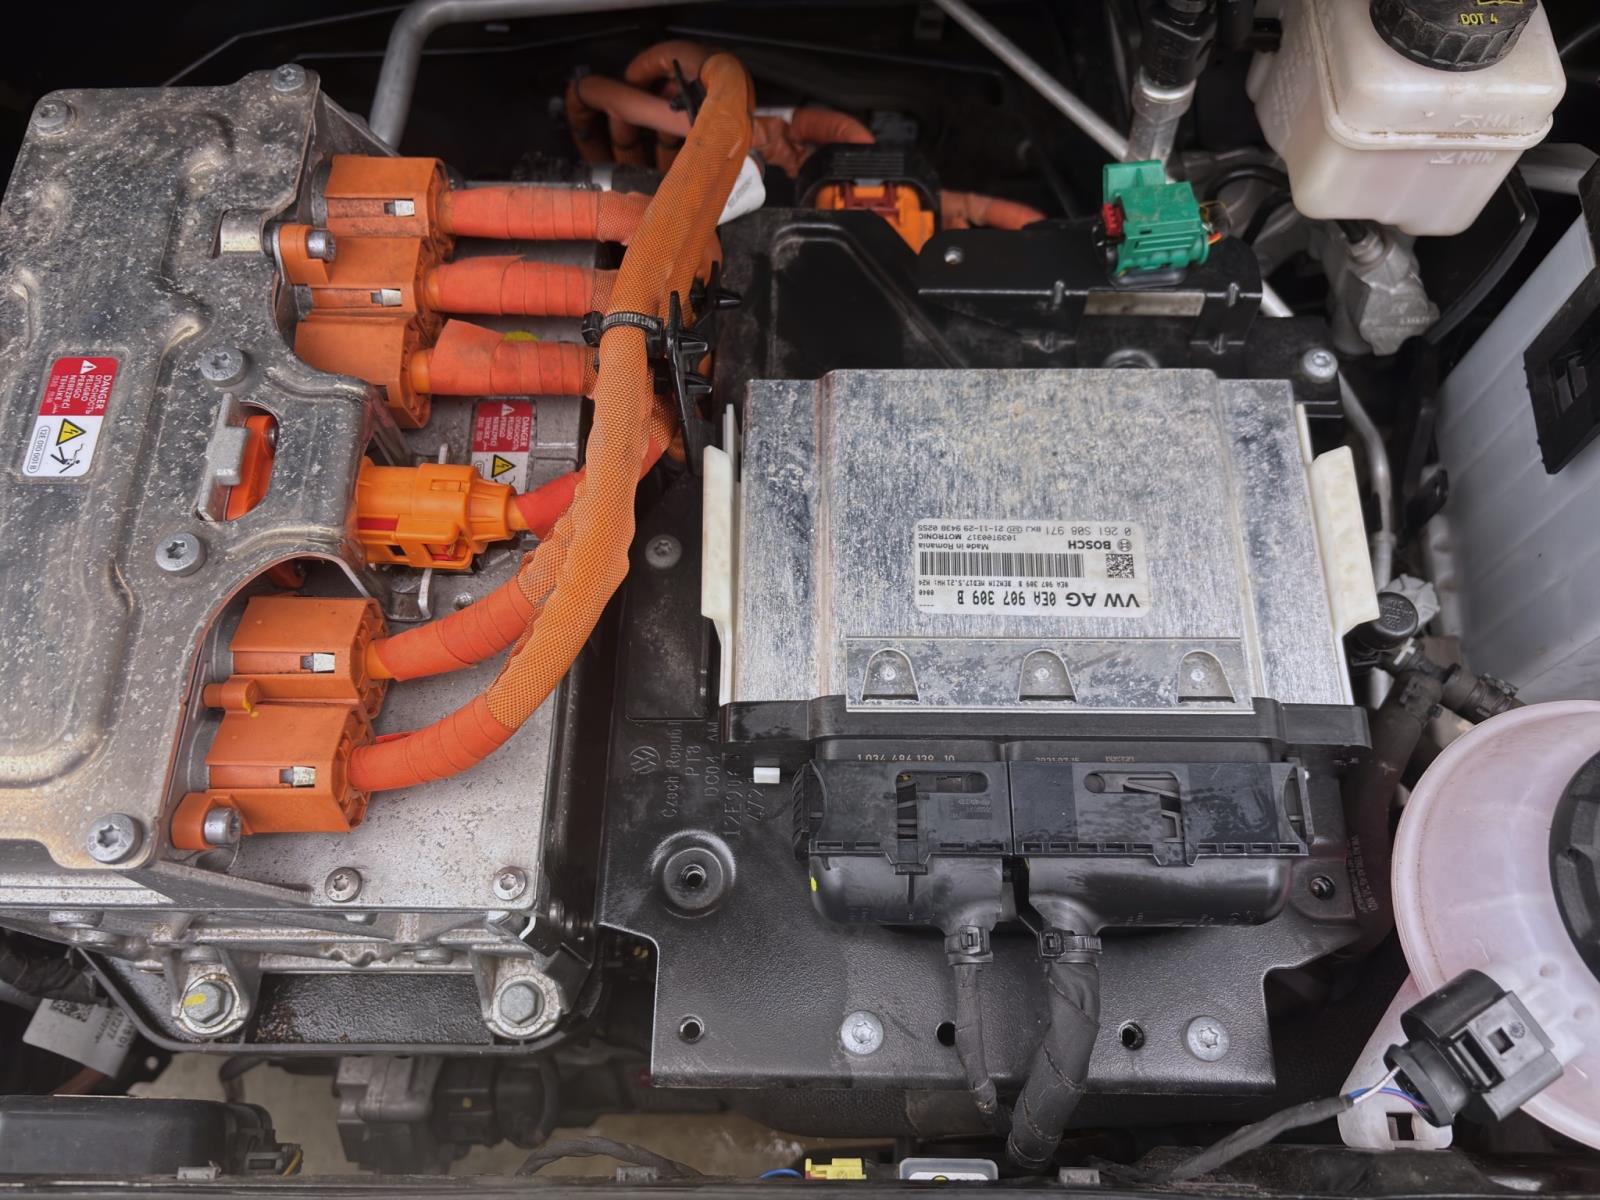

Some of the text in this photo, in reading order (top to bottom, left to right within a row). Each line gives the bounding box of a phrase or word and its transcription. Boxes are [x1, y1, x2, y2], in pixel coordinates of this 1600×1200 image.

[1460, 13, 1498, 25] DOT 4
[1458, 151, 1496, 165] MIN
[73, 375, 86, 398] PERIGO
[81, 375, 94, 402] PELIGRO
[95, 375, 112, 409] DANGER
[1046, 526, 1064, 535] 971
[1099, 526, 1118, 535] 261
[1124, 526, 1132, 536] 0
[918, 542, 953, 550] Romania
[1068, 540, 1112, 550] BOSCH
[957, 590, 964, 605] B
[972, 590, 995, 605] 309
[1003, 591, 1026, 605] 907
[1065, 592, 1097, 607] AG
[1104, 593, 1140, 608] VW
